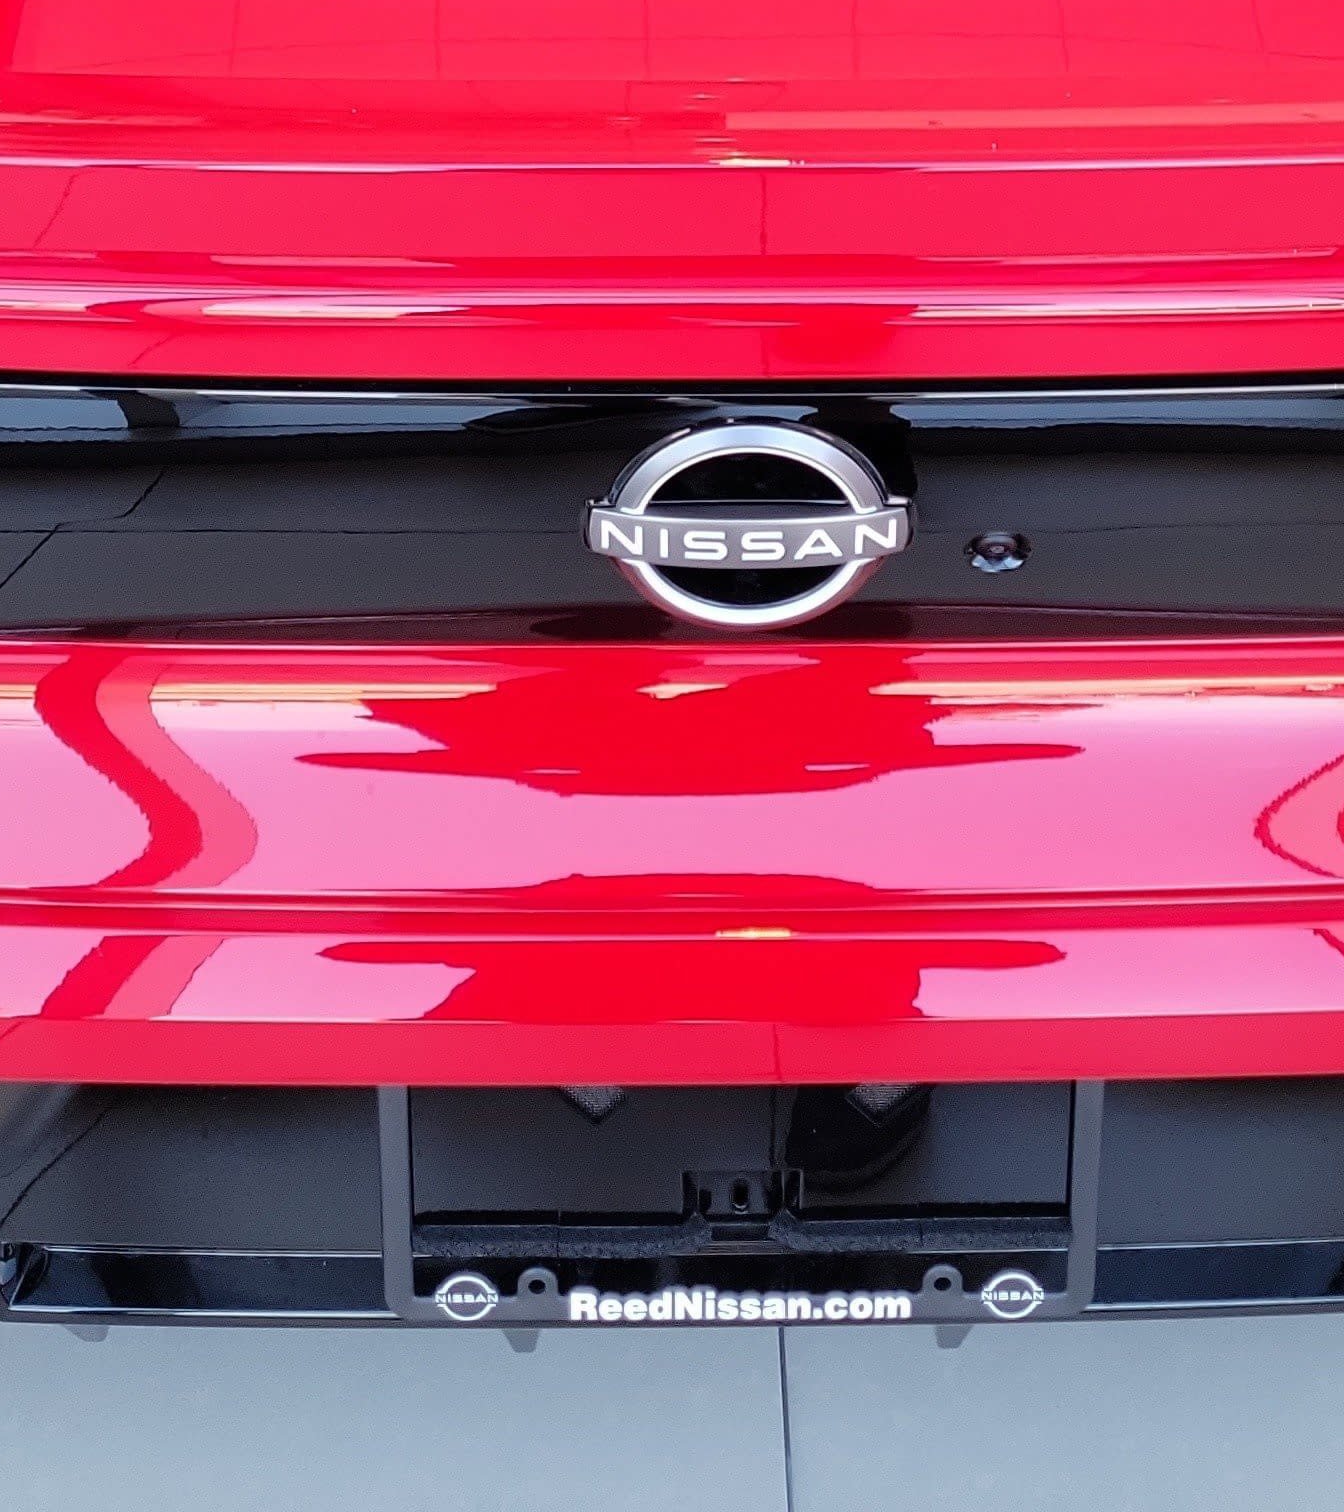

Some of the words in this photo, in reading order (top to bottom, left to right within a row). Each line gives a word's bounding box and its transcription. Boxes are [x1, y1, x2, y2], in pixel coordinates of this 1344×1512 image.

[600, 519, 897, 562] NISSAN
[435, 1292, 499, 1303] NISSAN
[570, 1291, 911, 1320] ReedNissan.com
[981, 1290, 1044, 1301] NISSAN
